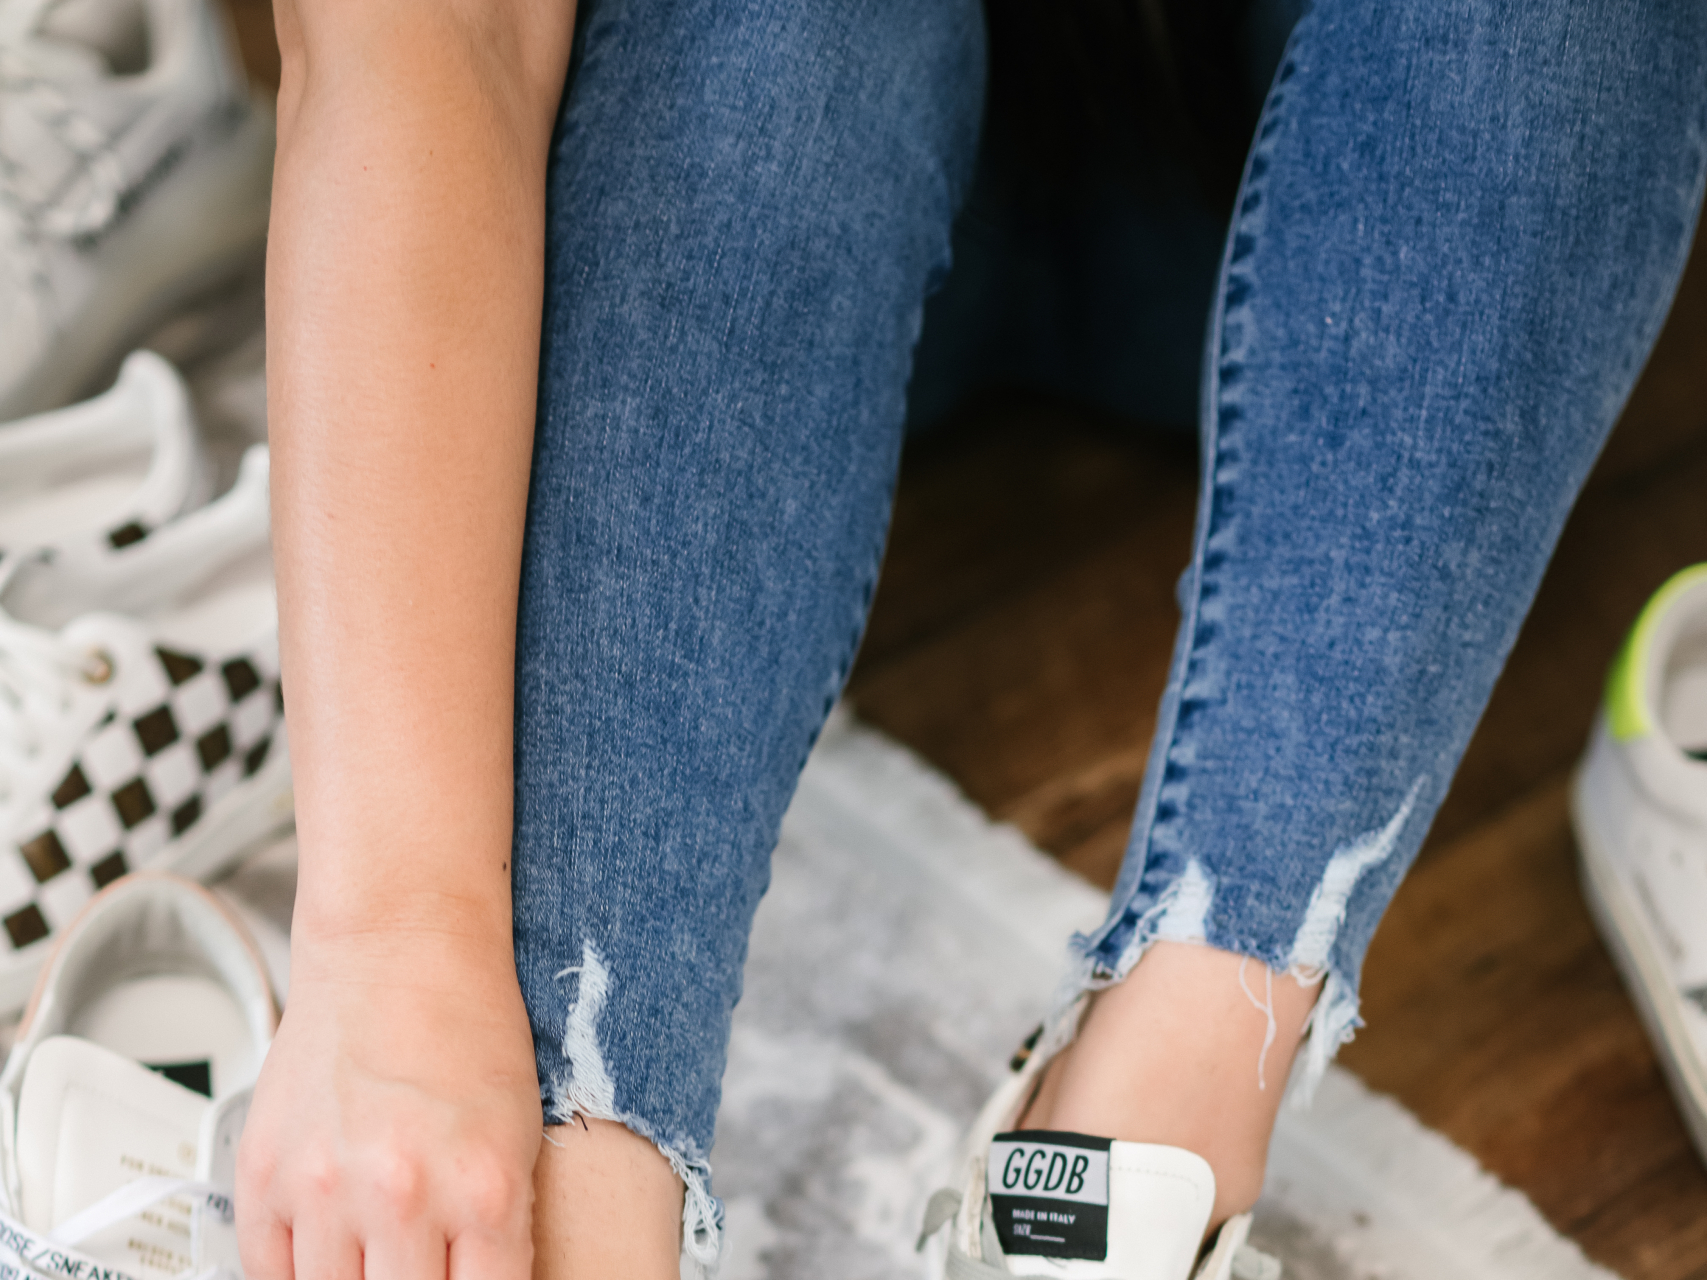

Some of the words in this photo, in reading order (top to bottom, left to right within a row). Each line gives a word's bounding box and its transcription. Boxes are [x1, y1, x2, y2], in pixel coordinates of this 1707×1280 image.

[1002, 1147, 1089, 1194] GGDB
[1012, 1209, 1035, 1220] MADE
[1037, 1211, 1047, 1221] IN
[1049, 1212, 1076, 1224] ITALY
